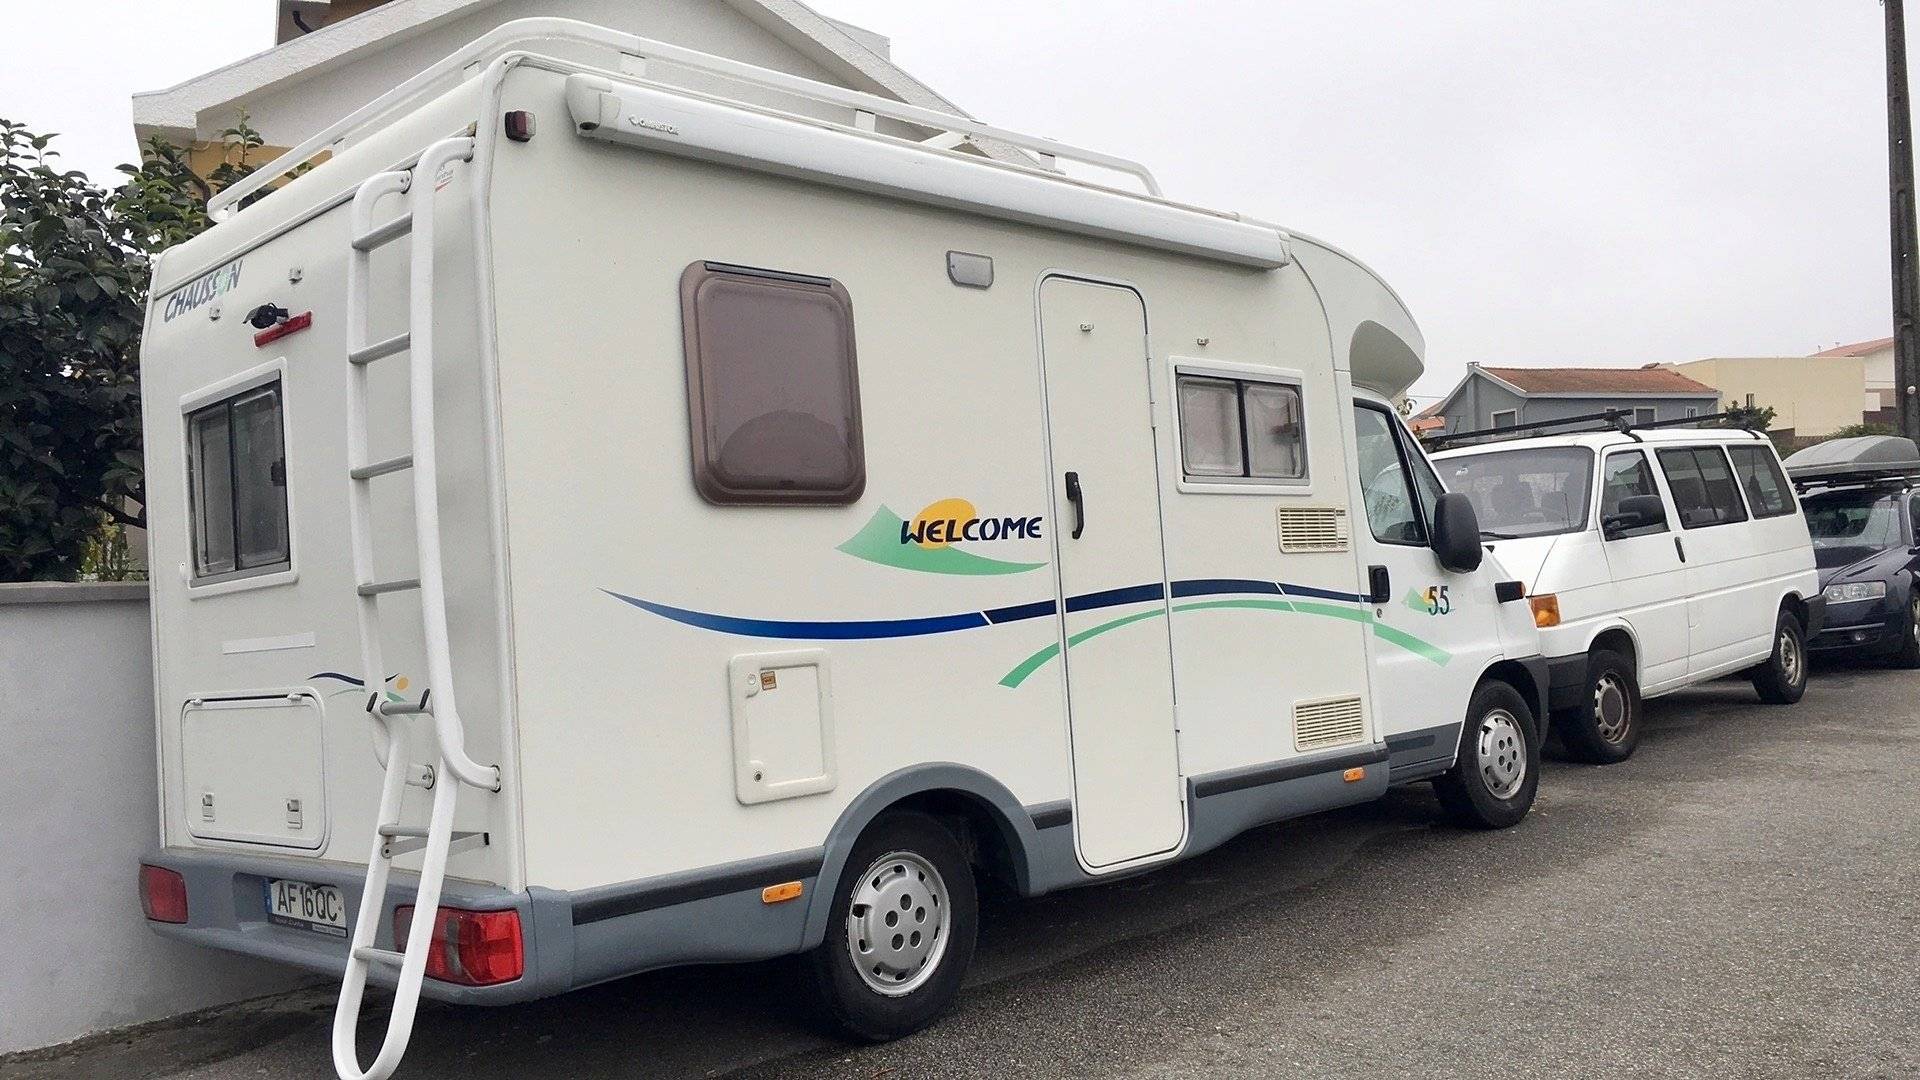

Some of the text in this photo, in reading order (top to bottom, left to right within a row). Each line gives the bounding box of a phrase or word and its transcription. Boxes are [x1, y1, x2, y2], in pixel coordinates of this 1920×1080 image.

[164, 259, 244, 323] CHAUSSON
[900, 517, 1042, 544] WELCOME
[1428, 585, 1450, 616] 55
